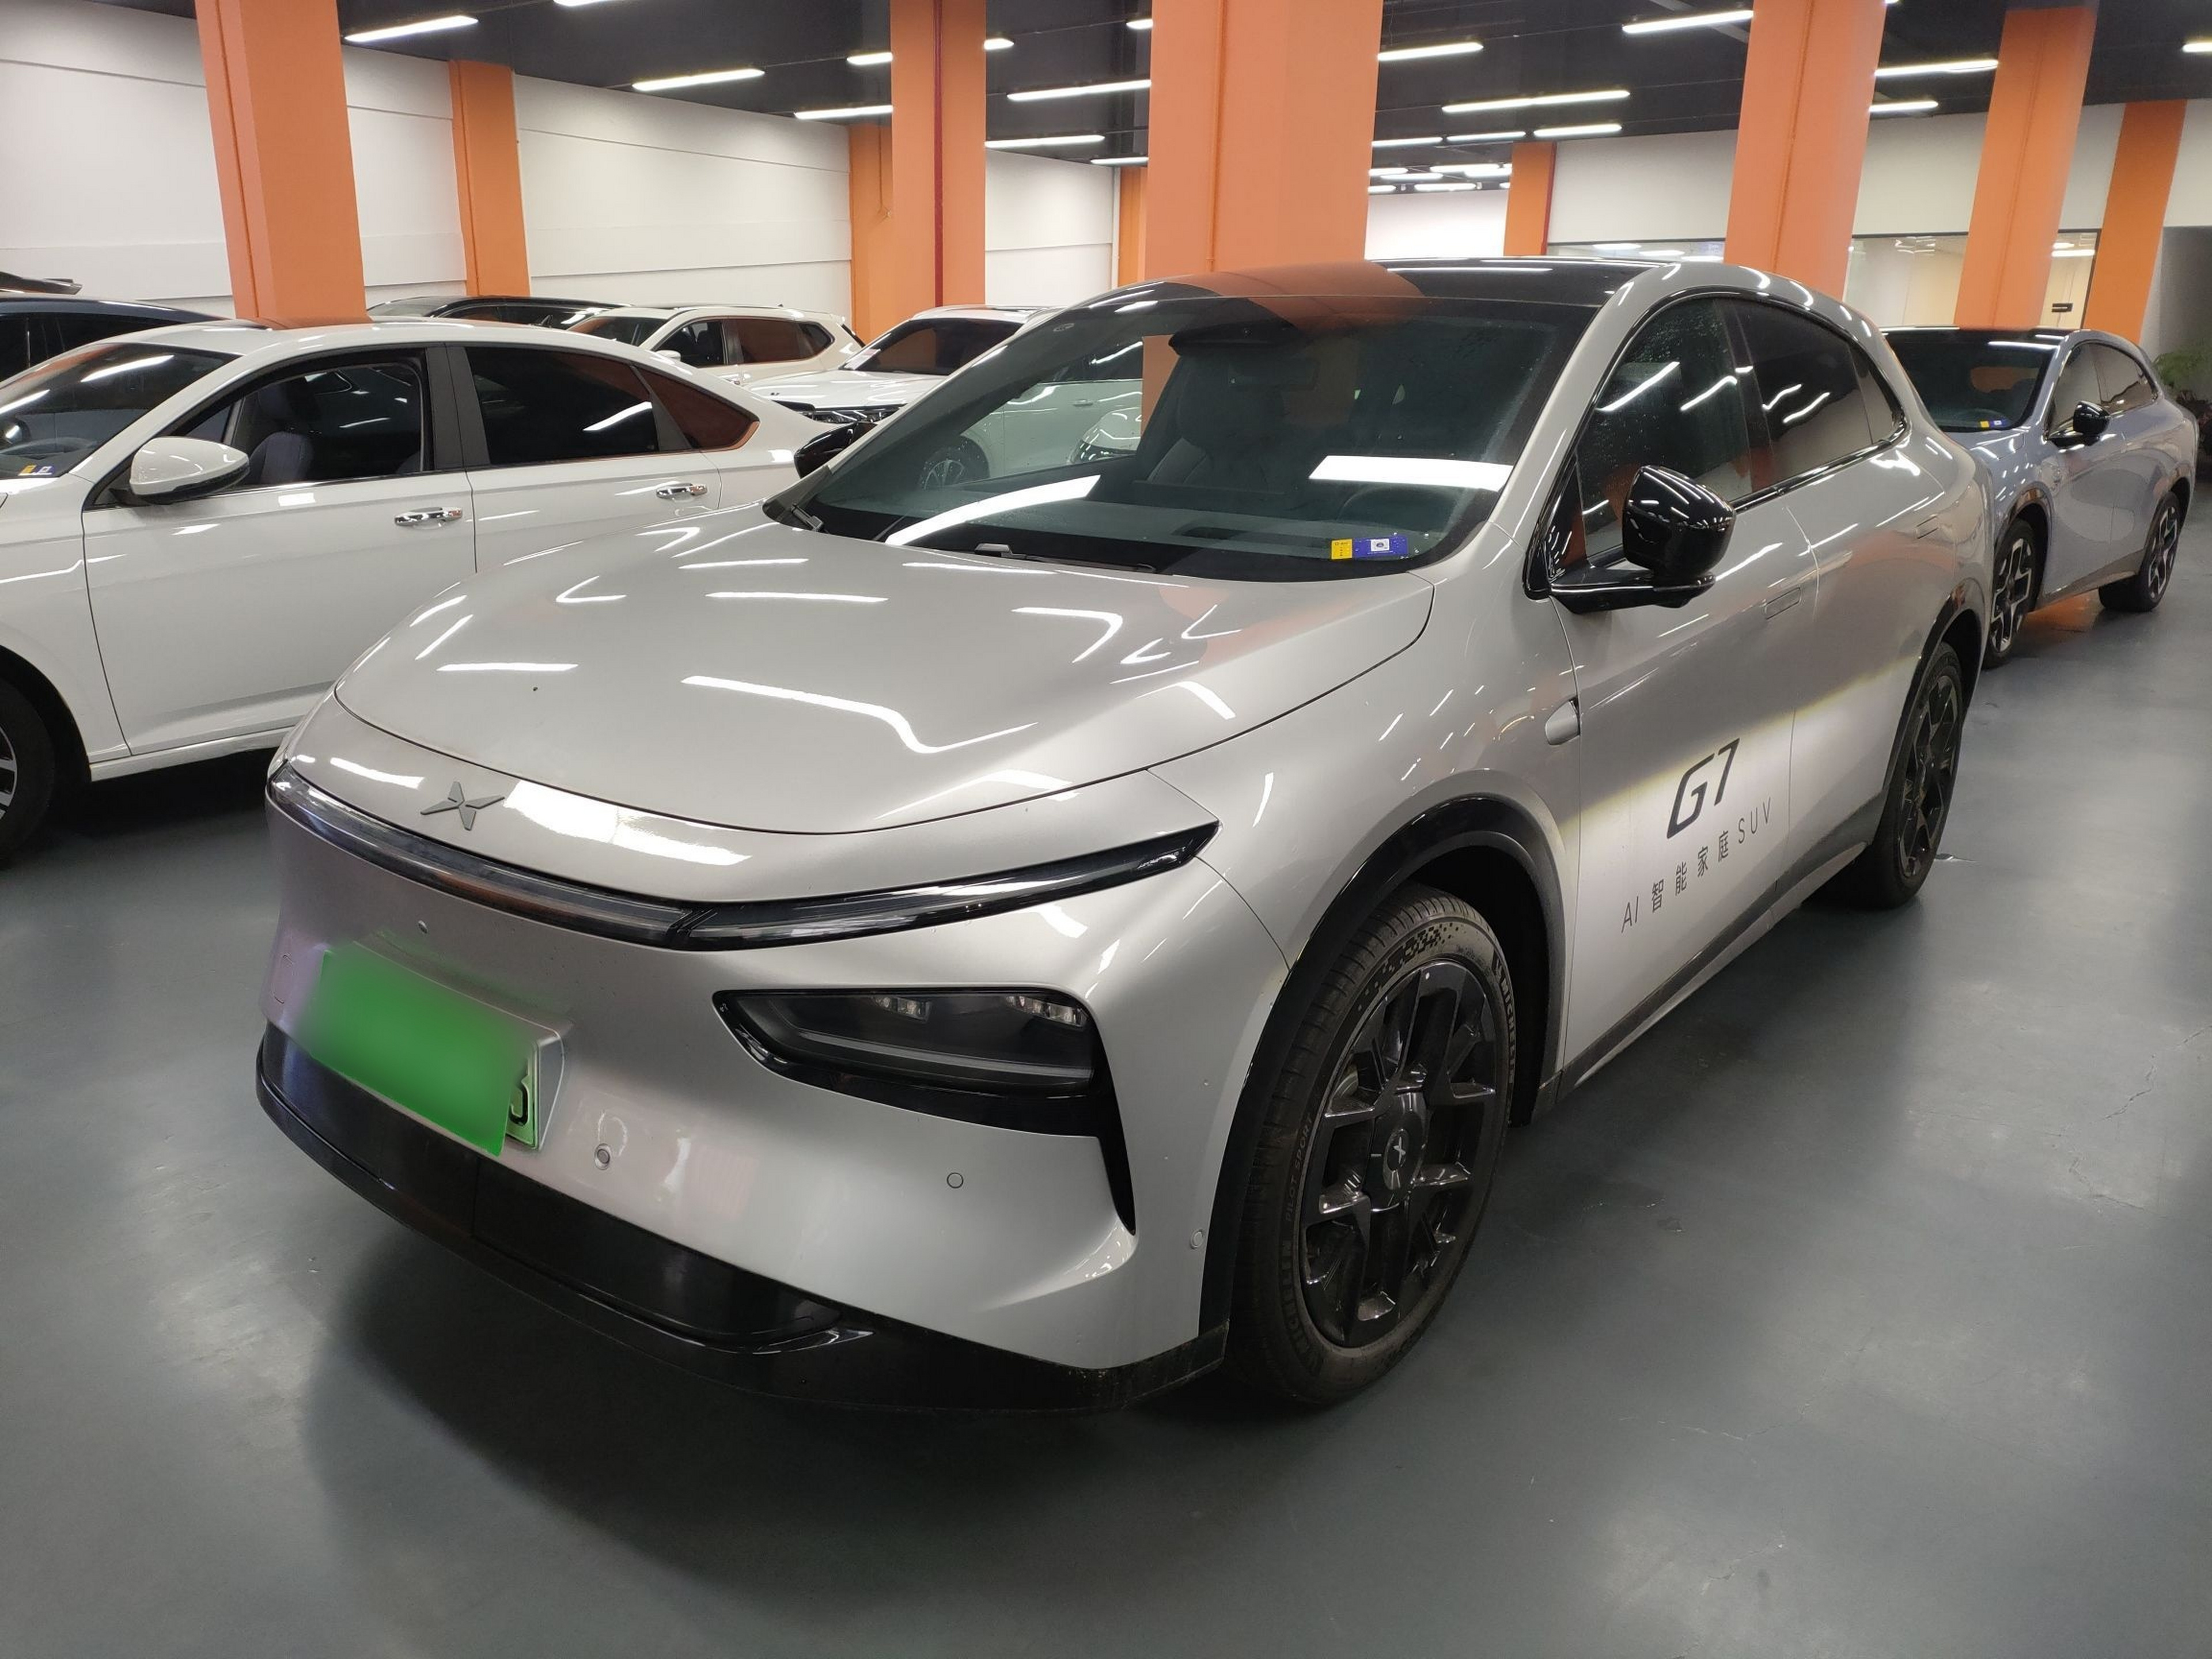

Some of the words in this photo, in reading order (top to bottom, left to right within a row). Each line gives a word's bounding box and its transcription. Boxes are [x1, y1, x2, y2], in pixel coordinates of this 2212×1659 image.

[1666, 737, 1740, 839] G7
[1621, 895, 1639, 933] AI
[1652, 830, 1729, 912] 智能家庭
[1737, 797, 1771, 844] SUV
[1284, 1175, 1296, 1222] PILOT
[1294, 1112, 1313, 1170] SPORT
